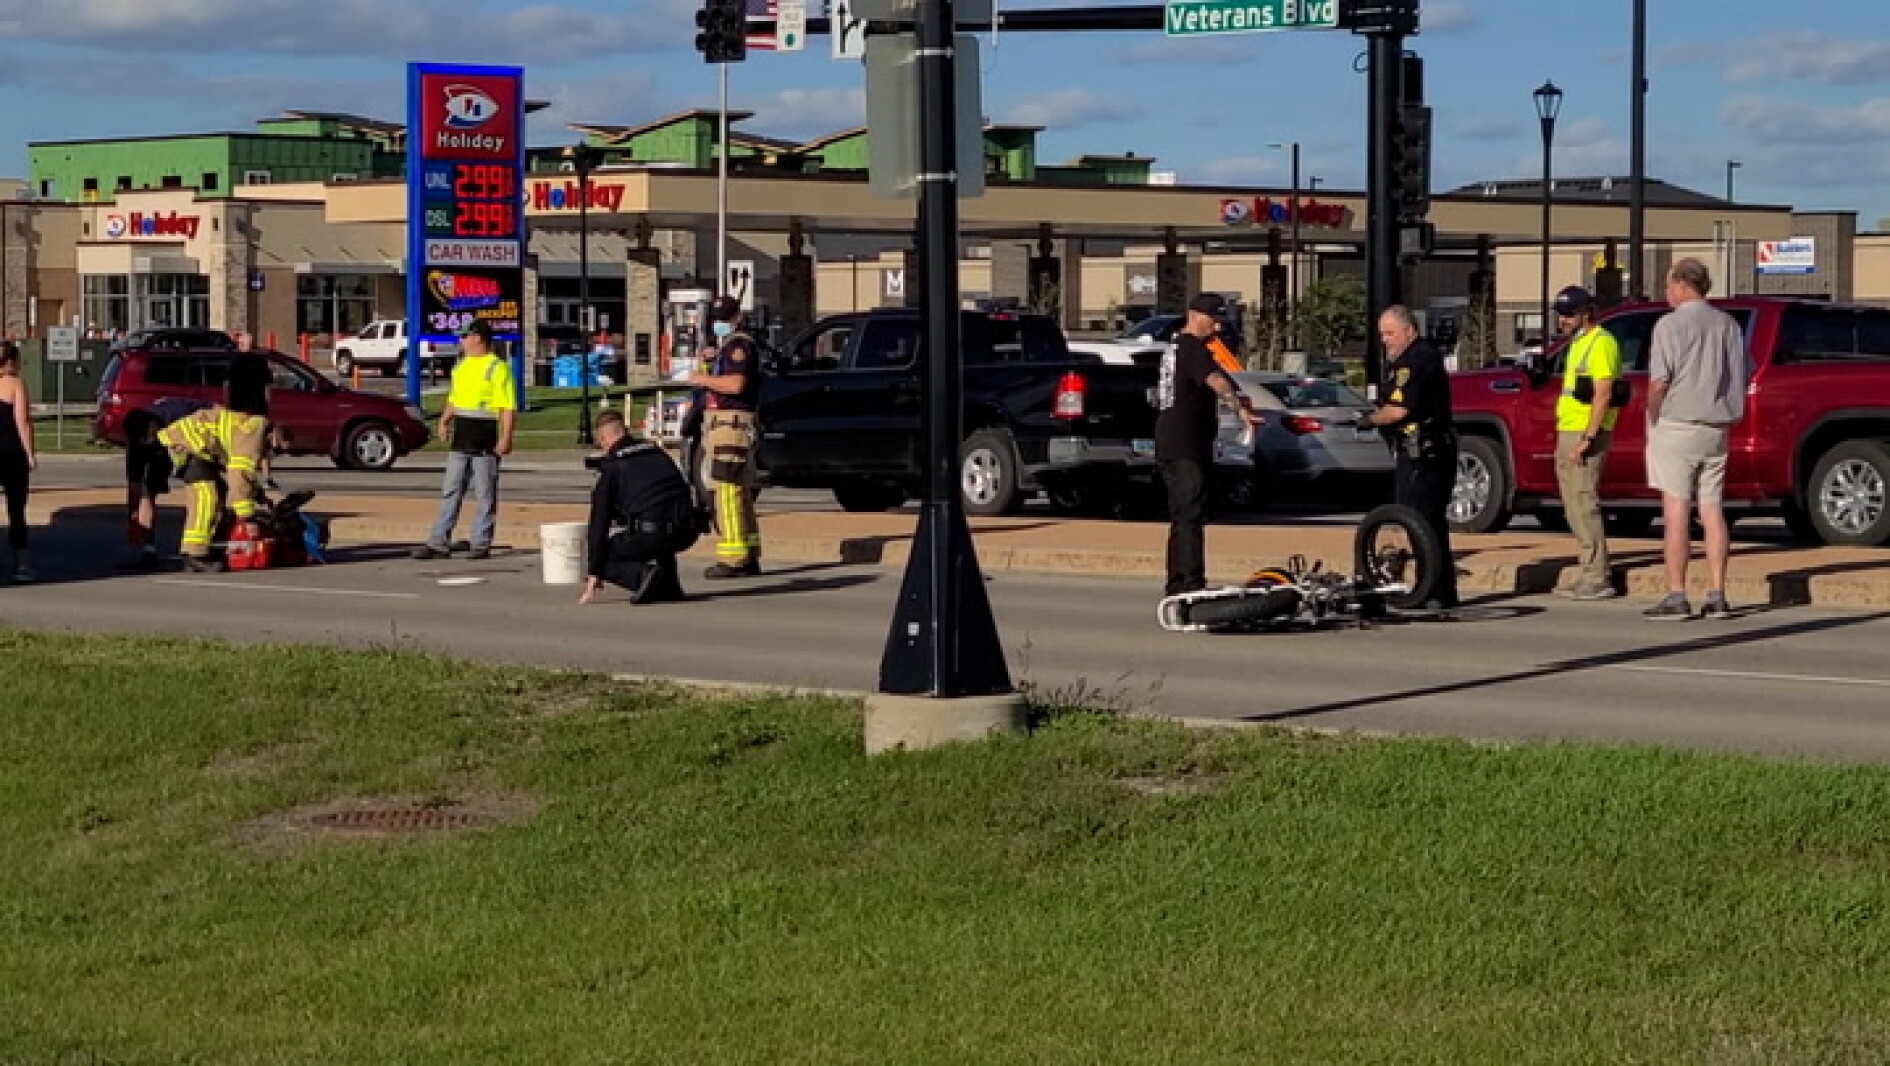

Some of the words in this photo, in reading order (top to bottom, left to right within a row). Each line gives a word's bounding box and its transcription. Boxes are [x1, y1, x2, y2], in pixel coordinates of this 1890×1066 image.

[1170, 4, 1274, 30] Veterans
[1282, 0, 1335, 24] Blvd
[436, 131, 504, 153] Holiday
[130, 210, 200, 239] Holiday
[425, 208, 452, 228] DSL
[429, 243, 463, 261] CAR
[466, 243, 516, 261] WASH
